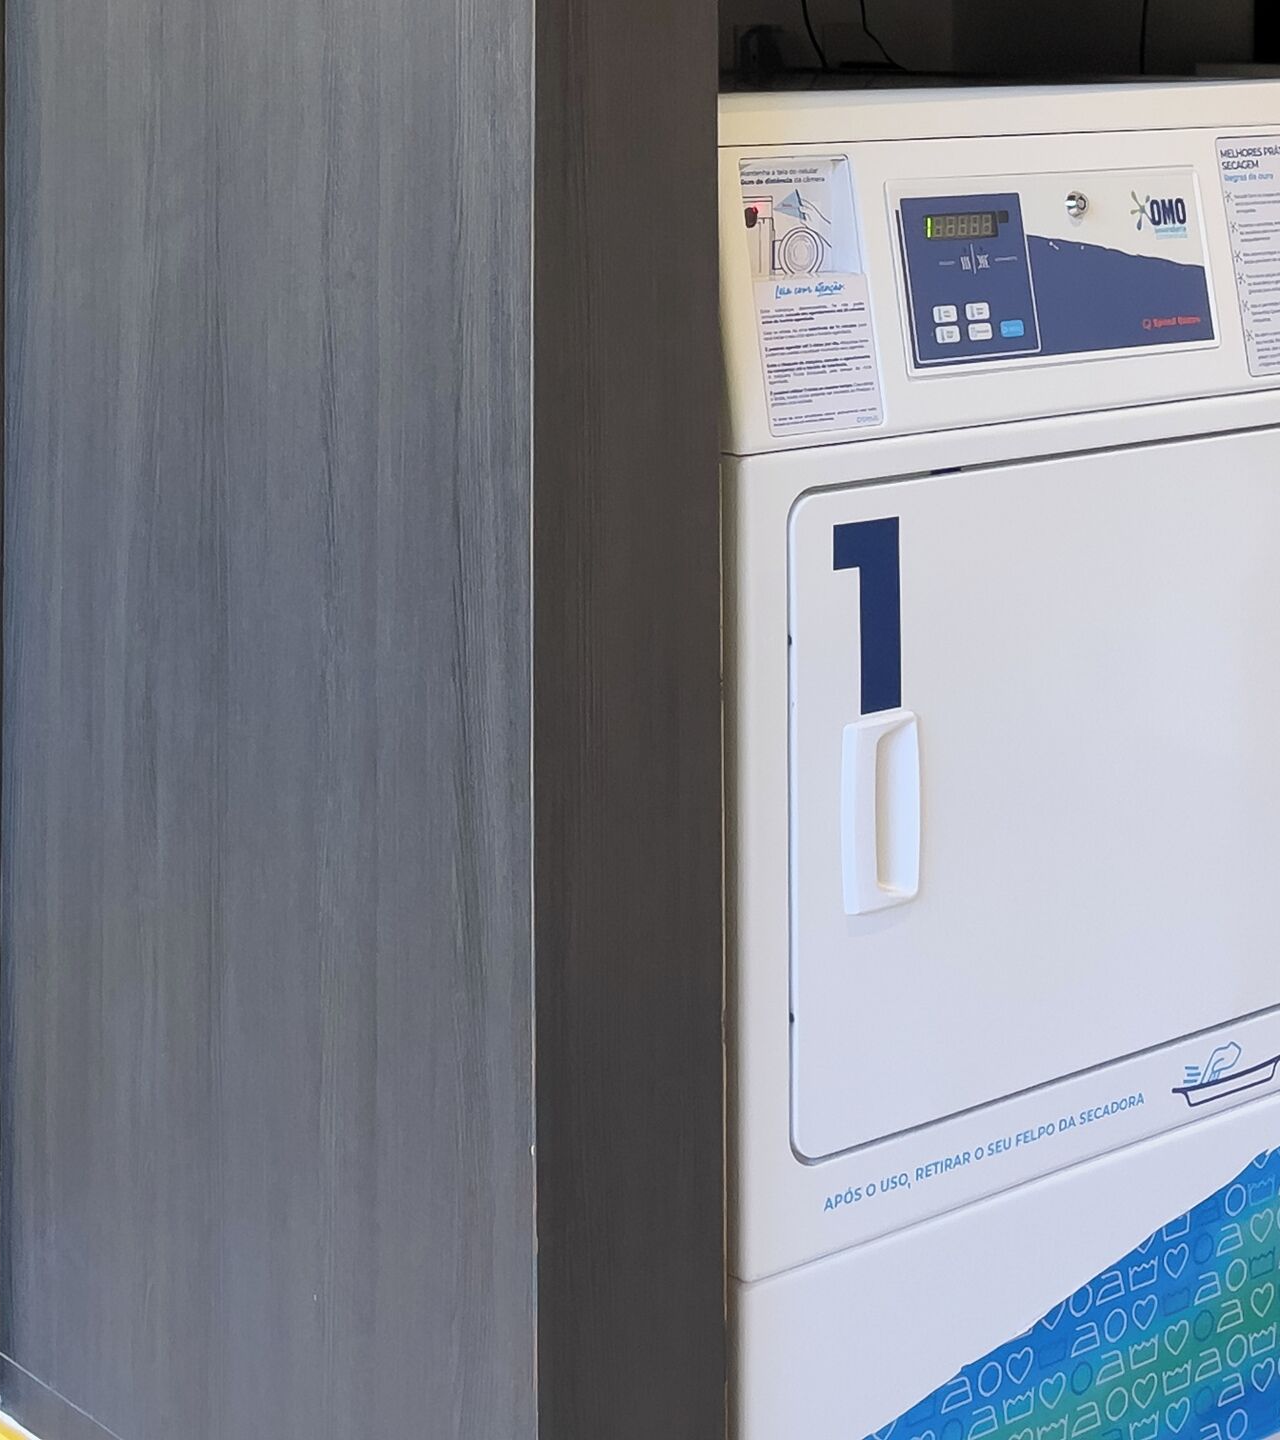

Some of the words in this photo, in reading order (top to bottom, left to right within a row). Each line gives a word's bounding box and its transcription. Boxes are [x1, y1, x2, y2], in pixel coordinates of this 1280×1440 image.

[1220, 147, 1263, 158] MELHORES
[1221, 160, 1259, 171] SECAGEM
[1149, 197, 1187, 226] OMO
[833, 516, 902, 715] 1
[823, 1187, 862, 1212] APÓS
[865, 1183, 877, 1197] O
[880, 1173, 912, 1193] USO,
[915, 1151, 971, 1182] RETIRAR
[974, 1147, 985, 1161] O
[987, 1136, 1012, 1157] SEU
[1015, 1122, 1056, 1147] FELPO
[1058, 1115, 1076, 1133] DA
[1079, 1091, 1145, 1126] SECADORA
